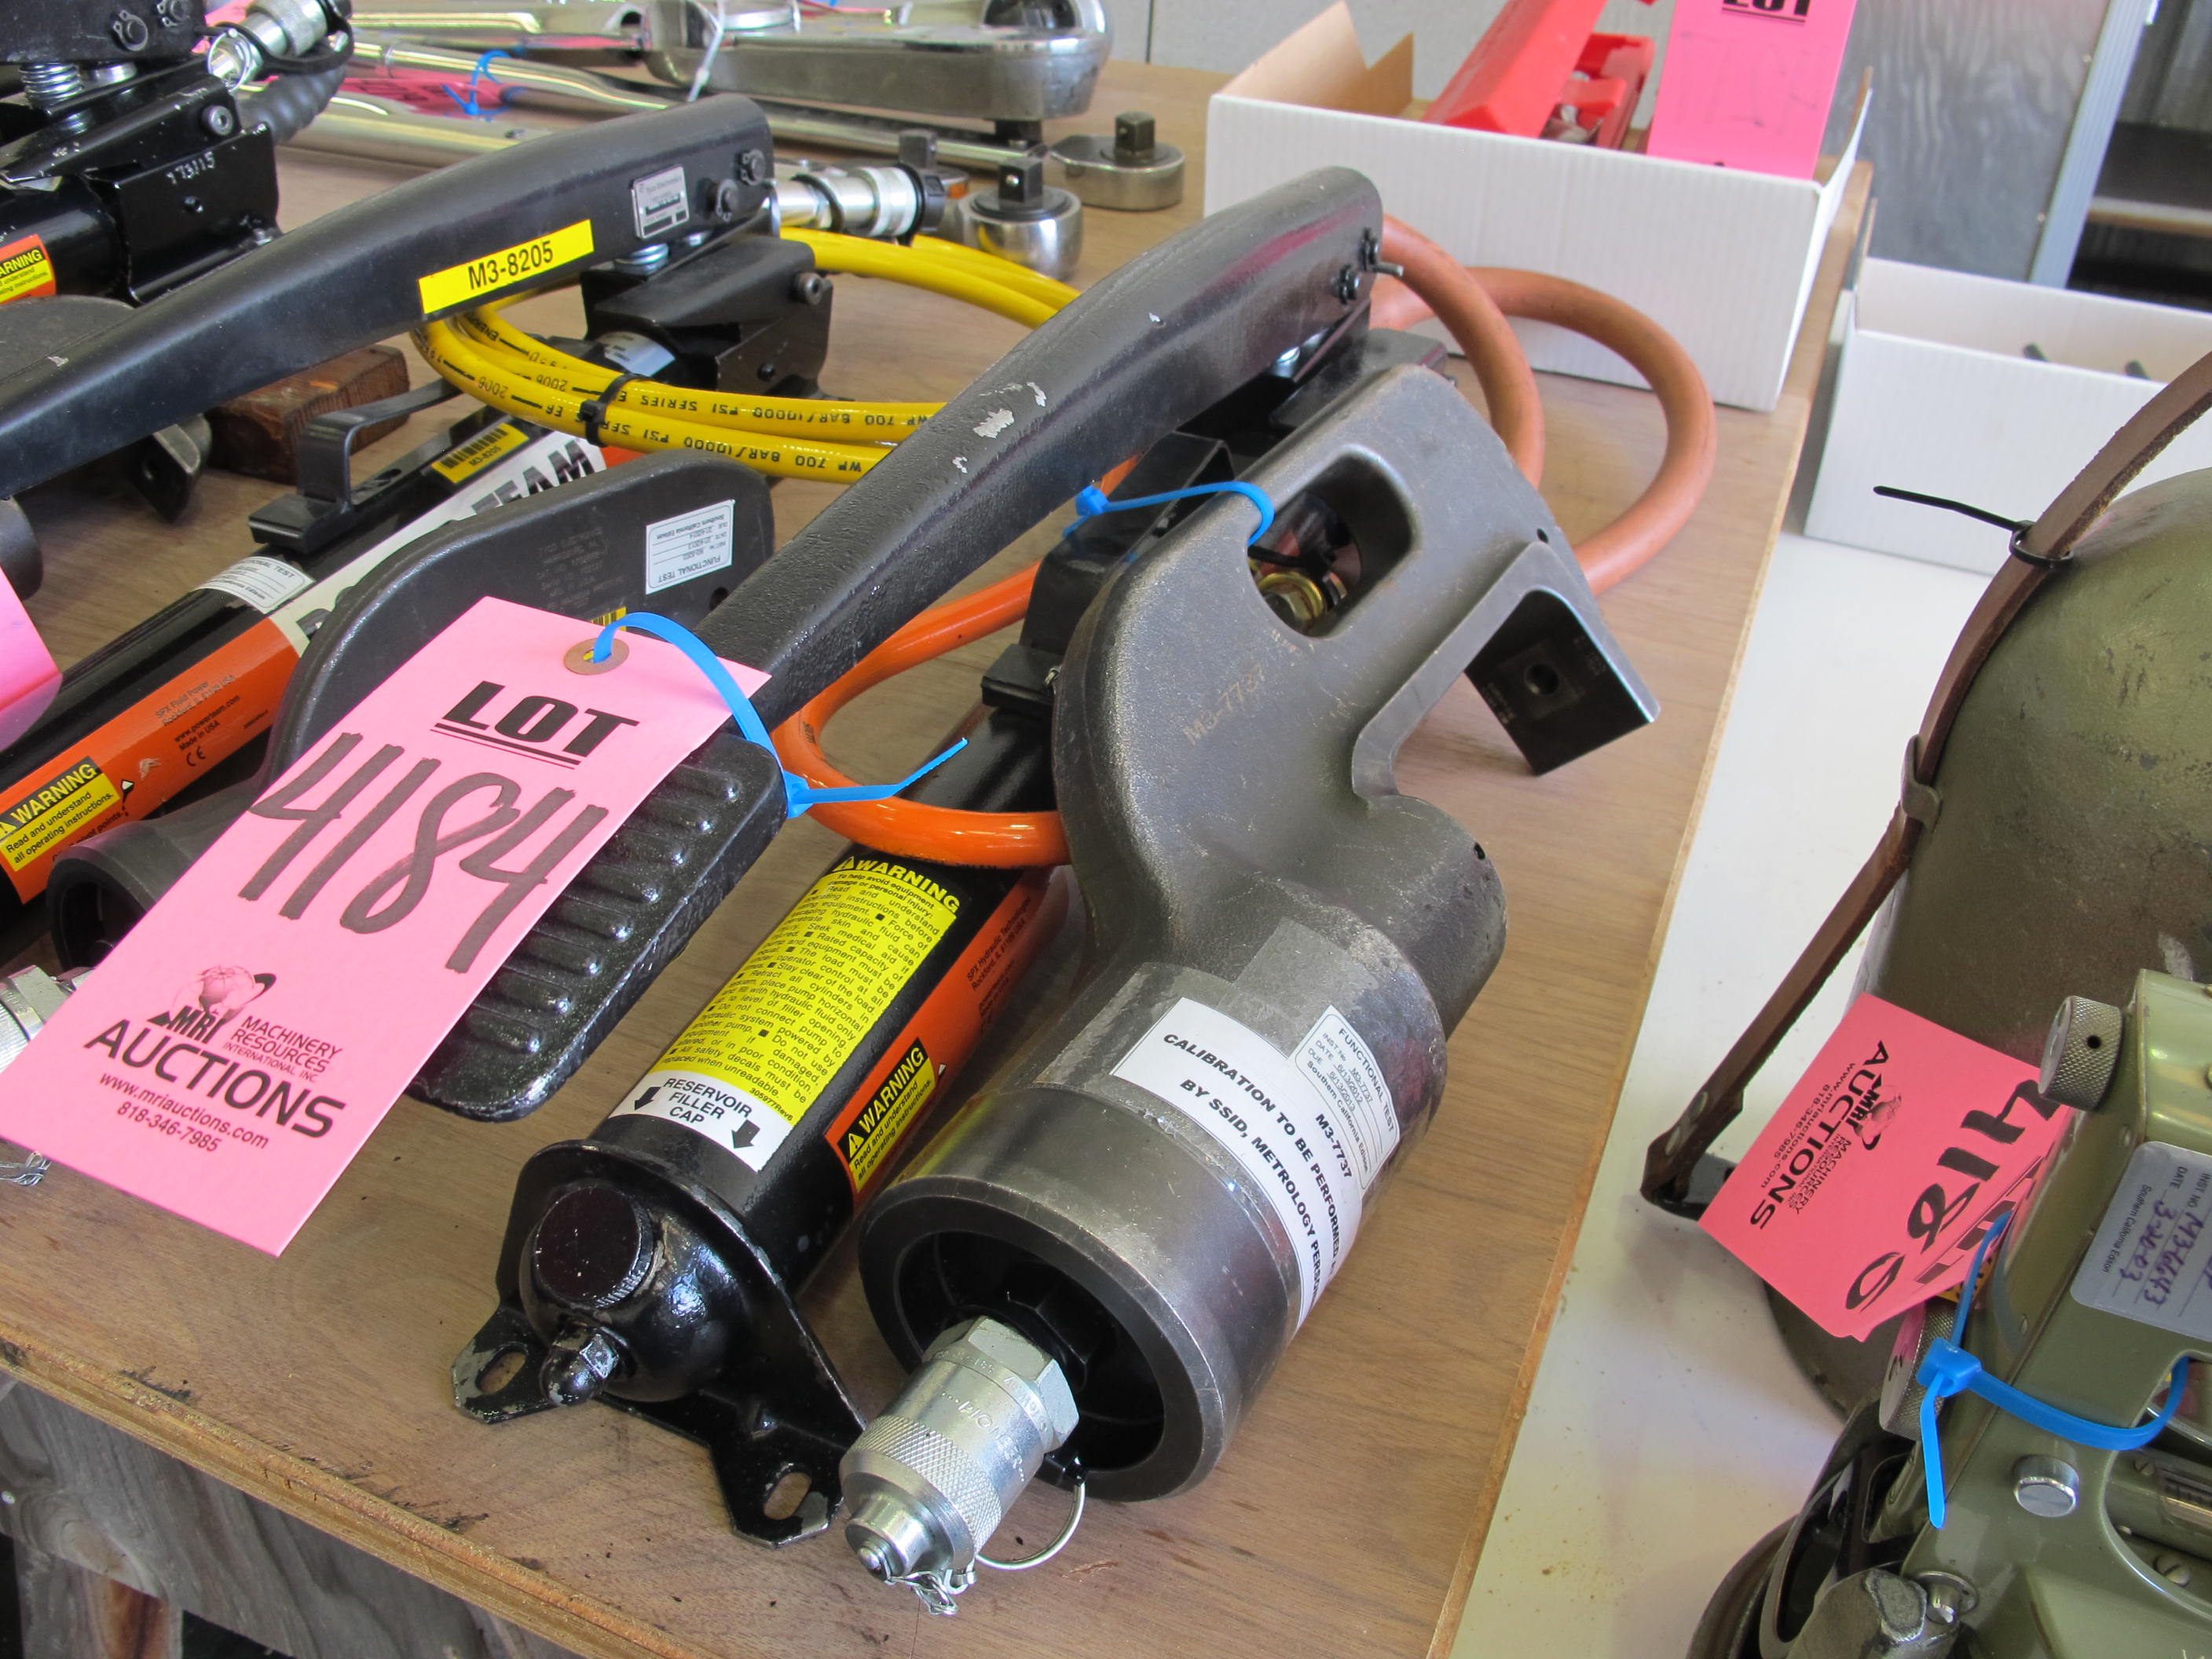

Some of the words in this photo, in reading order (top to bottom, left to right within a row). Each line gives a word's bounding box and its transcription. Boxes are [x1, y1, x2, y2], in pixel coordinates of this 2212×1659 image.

[0, 249, 43, 276] ARNING
[468, 240, 554, 291] M3-8205
[477, 375, 508, 398] 2006
[638, 392, 697, 411] SERIES
[711, 402, 738, 416] PSI
[574, 412, 630, 435] SERS
[643, 428, 668, 442] PSI
[752, 406, 850, 423] BAR/10000
[863, 414, 895, 426] 700
[683, 436, 779, 461] BAR/10000
[794, 454, 826, 467] 700
[838, 460, 861, 471] WP
[656, 570, 675, 583] TEST
[676, 555, 720, 575] FUNCTIONAL
[178, 734, 198, 751] Made
[196, 729, 205, 738] in
[203, 719, 220, 734] USA
[442, 680, 640, 757] LOT
[10, 760, 97, 827] WARNING
[5, 833, 29, 852] Read
[28, 822, 46, 837] and
[46, 790, 91, 826] understand
[13, 851, 25, 863] all
[24, 824, 65, 856] operating
[64, 790, 113, 828] instructions.
[238, 732, 609, 973] 4184
[851, 858, 961, 914] WARNING
[866, 873, 890, 886] avoid
[888, 881, 935, 910] equipment
[868, 881, 906, 902] personal
[830, 906, 874, 928] hydraulic
[878, 924, 900, 943] fluid
[903, 943, 921, 959] can
[846, 892, 900, 920] instructions
[904, 914, 934, 943] before
[859, 887, 878, 900] and
[888, 898, 940, 935] understand
[887, 918, 914, 941] Force
[807, 936, 857, 964] equipment
[858, 959, 882, 980] must
[882, 976, 897, 991] be
[816, 929, 846, 947] Rated
[848, 943, 890, 973] capacity
[830, 916, 851, 929] skin
[859, 927, 880, 941] and
[887, 943, 915, 966] cause
[837, 926, 876, 950] medical
[880, 950, 897, 965] aid
[965, 965, 980, 981] SPX
[976, 934, 1003, 967] Hydraulic
[799, 965, 825, 982] clear
[837, 983, 853, 998] the
[853, 994, 877, 1015] load.
[808, 982, 854, 1011] cylinders
[819, 962, 854, 985] control
[870, 994, 884, 1007] all
[821, 952, 844, 969] load
[848, 966, 873, 986] must
[876, 984, 890, 999] be
[167, 1004, 228, 1045] MRI
[754, 1004, 795, 1027] connect
[798, 1024, 827, 1049] pump
[768, 987, 813, 1013] hydraulic
[813, 1006, 836, 1026] fluid
[835, 1022, 856, 1042] only
[781, 1002, 805, 1020] filler
[807, 1016, 849, 1051] opening.
[787, 983, 816, 1002] pump
[818, 996, 864, 1033] horizontal
[230, 1027, 329, 1074] RESOURCES
[240, 1016, 342, 1060] MACHINERY
[737, 1011, 775, 1031] system
[776, 1024, 821, 1055] powered
[771, 1032, 787, 1049] Do
[790, 1046, 808, 1060] not
[809, 1059, 829, 1077] use
[83, 1018, 346, 1140] AUCTIONS
[222, 1040, 296, 1075] INTERNATIONAL
[723, 1061, 782, 1099] unreadable.
[727, 1050, 761, 1073] decals
[764, 1070, 790, 1092] must
[738, 1044, 764, 1061] poor
[766, 1057, 814, 1094] condition.
[772, 1046, 822, 1086] damaged,
[1306, 1047, 1324, 1065] DUE
[1327, 1071, 1357, 1111] 6/13/2013
[1314, 1038, 1335, 1060] DATE
[1335, 1064, 1364, 1104] 6/13/2012
[1321, 1032, 1339, 1051] INST
[1336, 1049, 1347, 1062] No
[1350, 1067, 1374, 1103] M3-7737
[1337, 1027, 1385, 1103] FUNCTIONAL
[1380, 1102, 1396, 1133] TEST
[99, 1071, 269, 1149] www.mriauctions.com
[662, 1078, 753, 1119] RESERVOIR
[668, 1090, 725, 1119] FILLER
[749, 1086, 794, 1122] 305977Rev6
[858, 1045, 926, 1133] WARNING
[1306, 1060, 1339, 1100] Southern
[1335, 1099, 1362, 1143] California
[1844, 1088, 1881, 1130] MRI
[116, 1101, 221, 1153] 818-346-7985
[668, 1105, 705, 1126] CAP
[851, 1143, 873, 1170] Read
[868, 1126, 884, 1147] and
[881, 1079, 921, 1129] understand
[863, 1125, 899, 1167] operating
[892, 1077, 932, 1126] instructions.
[1747, 1039, 1888, 1230] AUCTIONS
[1760, 1061, 1856, 1189] www.mriauctions.com
[1772, 1083, 1830, 1159] 818-346-7985
[1163, 1031, 1276, 1112] CALIBRATION
[1274, 1111, 1298, 1137] TO
[1294, 1137, 1314, 1162] BE
[1309, 1163, 1339, 1254] PERFORMED
[1179, 1077, 1210, 1101] BY
[1207, 1096, 1251, 1139] SSID,
[1250, 1136, 1317, 1236] METROLOGY
[1314, 1113, 1353, 1180] M3-7737
[1795, 1132, 1840, 1190] INTERNATIONAL
[1788, 1134, 1845, 1210] RESOURCES
[1792, 1138, 1852, 1215] MACHINERY
[2169, 1165, 2186, 1189] DATE
[2127, 1183, 2152, 1218] Southern
[2111, 1216, 2136, 1250] California
[2100, 1249, 2119, 1273] Edison
